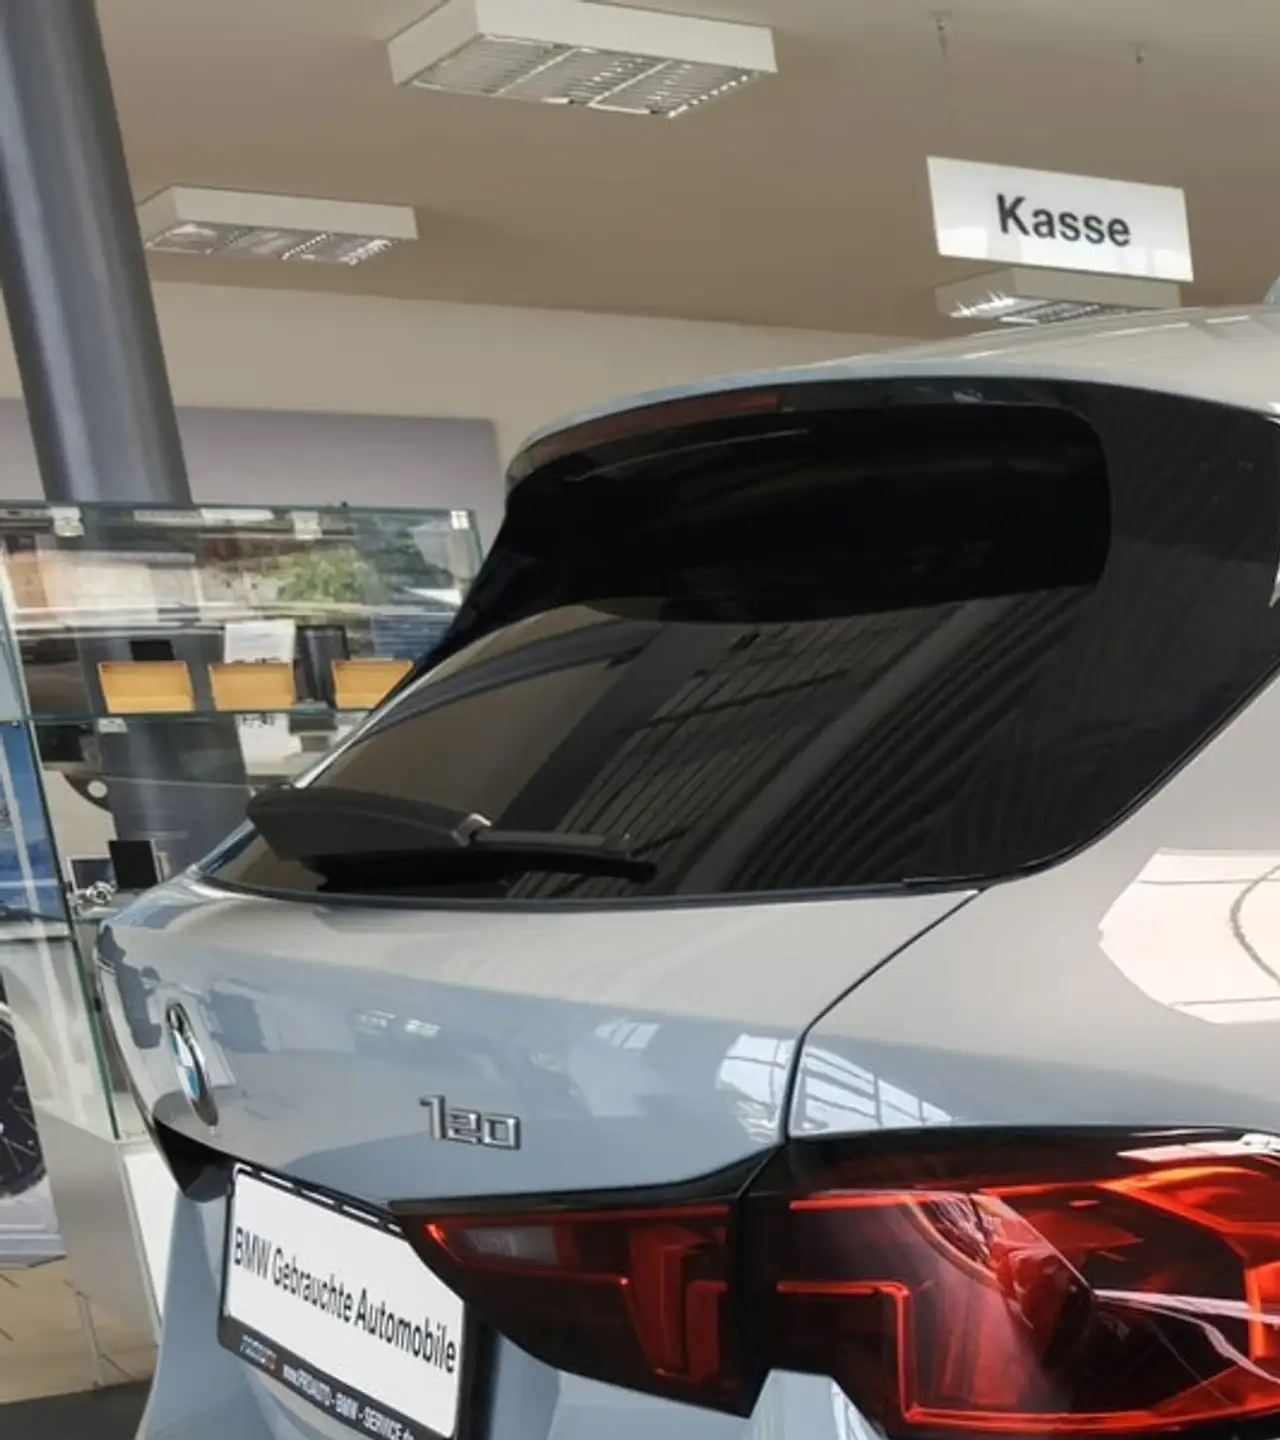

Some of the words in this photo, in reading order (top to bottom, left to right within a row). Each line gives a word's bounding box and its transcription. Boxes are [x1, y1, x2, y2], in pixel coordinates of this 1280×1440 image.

[997, 194, 1131, 247] Kasse
[419, 1095, 521, 1150] 120
[234, 1226, 272, 1279] BMW
[272, 1247, 353, 1323] Gebrauchte
[355, 1287, 457, 1374] Automobile
